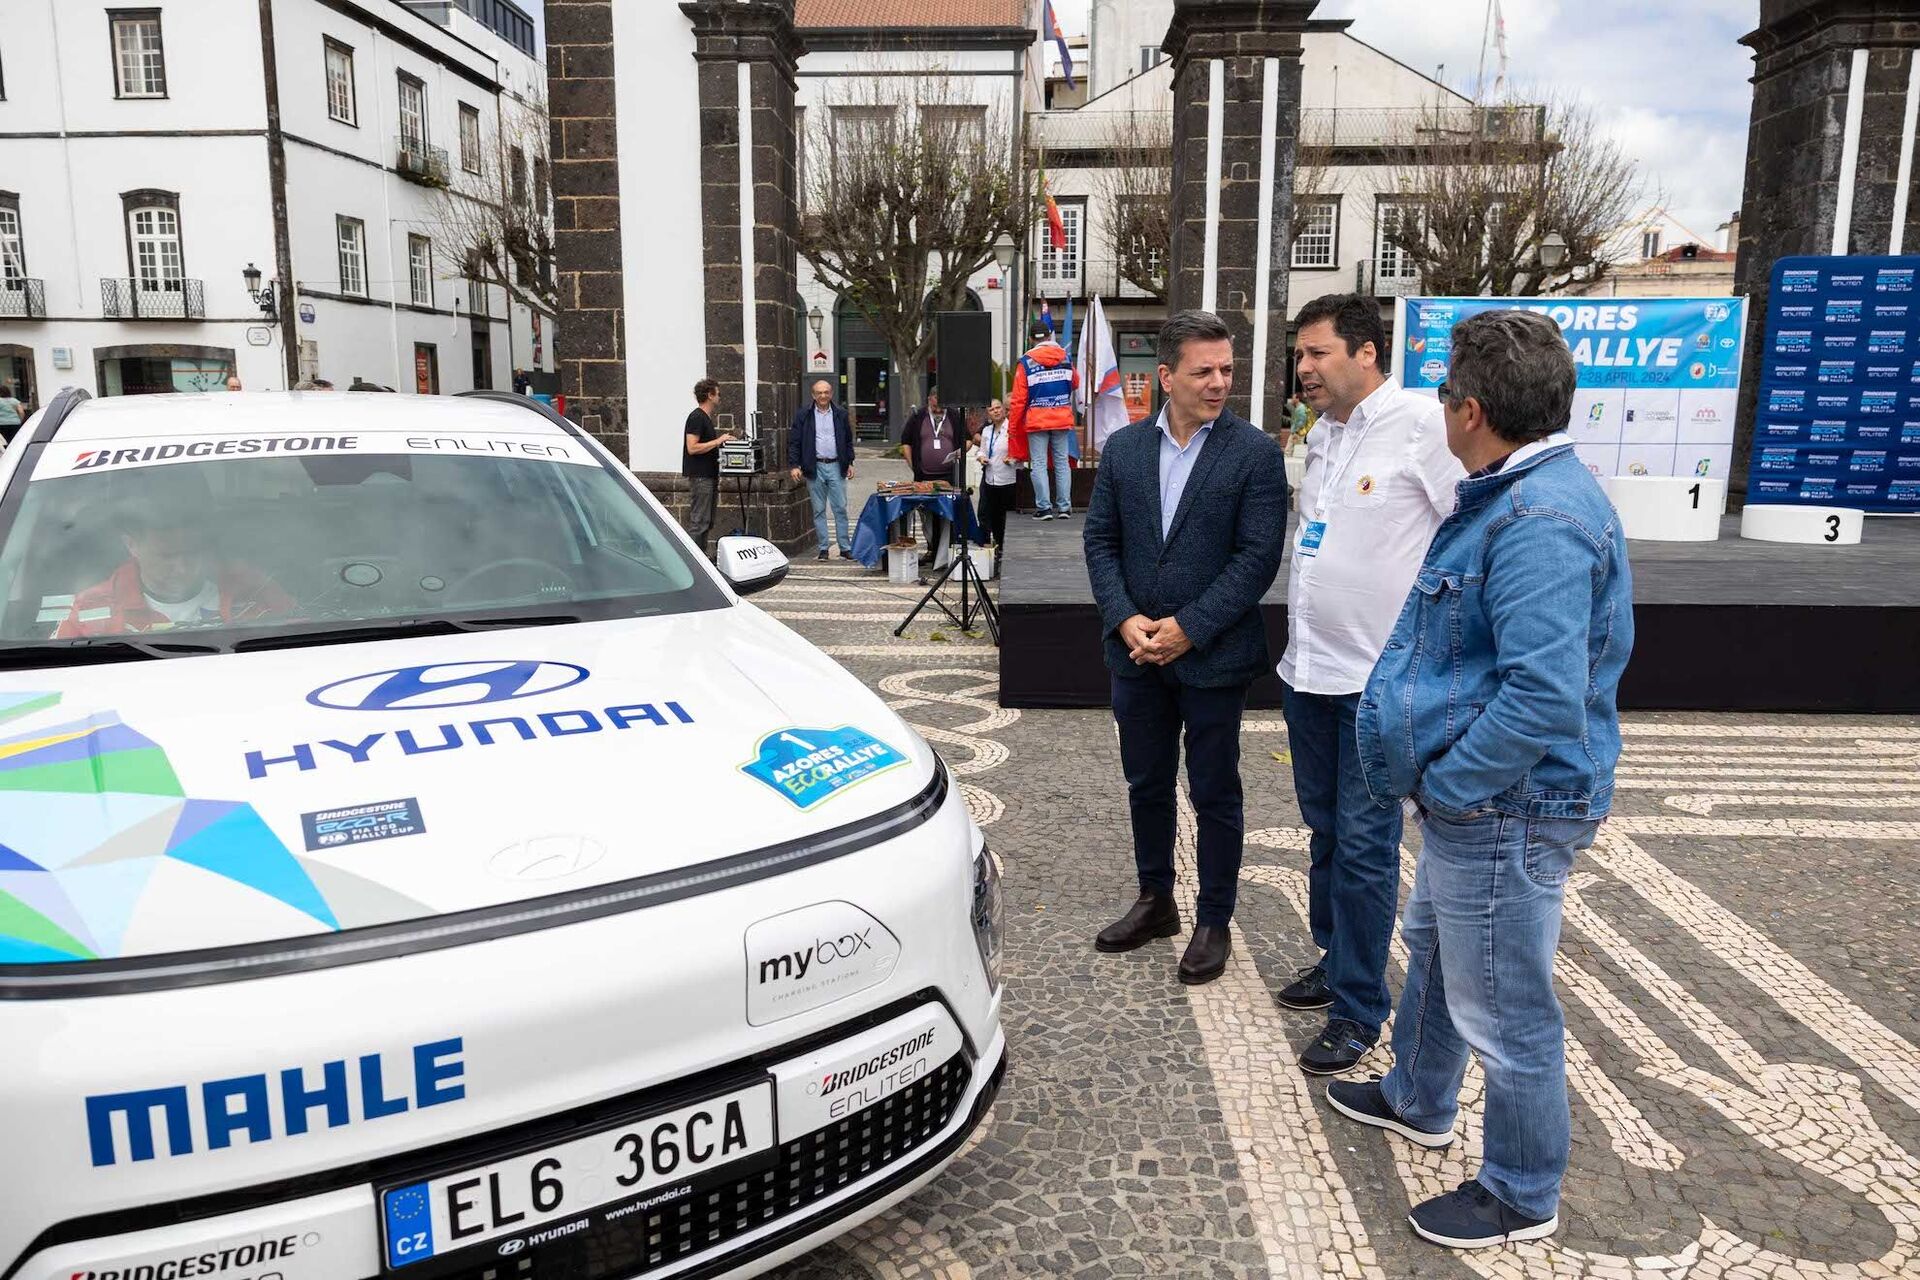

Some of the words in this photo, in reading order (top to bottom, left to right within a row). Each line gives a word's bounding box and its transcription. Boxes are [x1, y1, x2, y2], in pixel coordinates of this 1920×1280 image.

[1508, 305, 1639, 331] ORES
[1563, 338, 1683, 367] ALLYE
[72, 436, 358, 469] BRIDGESTONE
[406, 437, 571, 459] ENLITEN
[1689, 483, 1700, 509] 1
[1824, 515, 1840, 541] 3
[245, 701, 694, 778] HYUNDAI
[780, 732, 817, 751] 1
[772, 745, 845, 784] AZORES
[316, 801, 406, 820] BRIDGESTONE
[352, 831, 387, 840] RALLY
[391, 826, 414, 834] CUP
[760, 927, 871, 984] mybox
[820, 1027, 935, 1097] BRIDGESTONE
[84, 1037, 466, 1168] MAHLE
[830, 1058, 926, 1118] ENLITEN
[447, 1157, 564, 1240] EL6
[613, 1100, 748, 1187] 36CA
[605, 1184, 692, 1222] www.hyundai.cz
[396, 1231, 429, 1256] CZ
[529, 1218, 589, 1247] HYUNDAI
